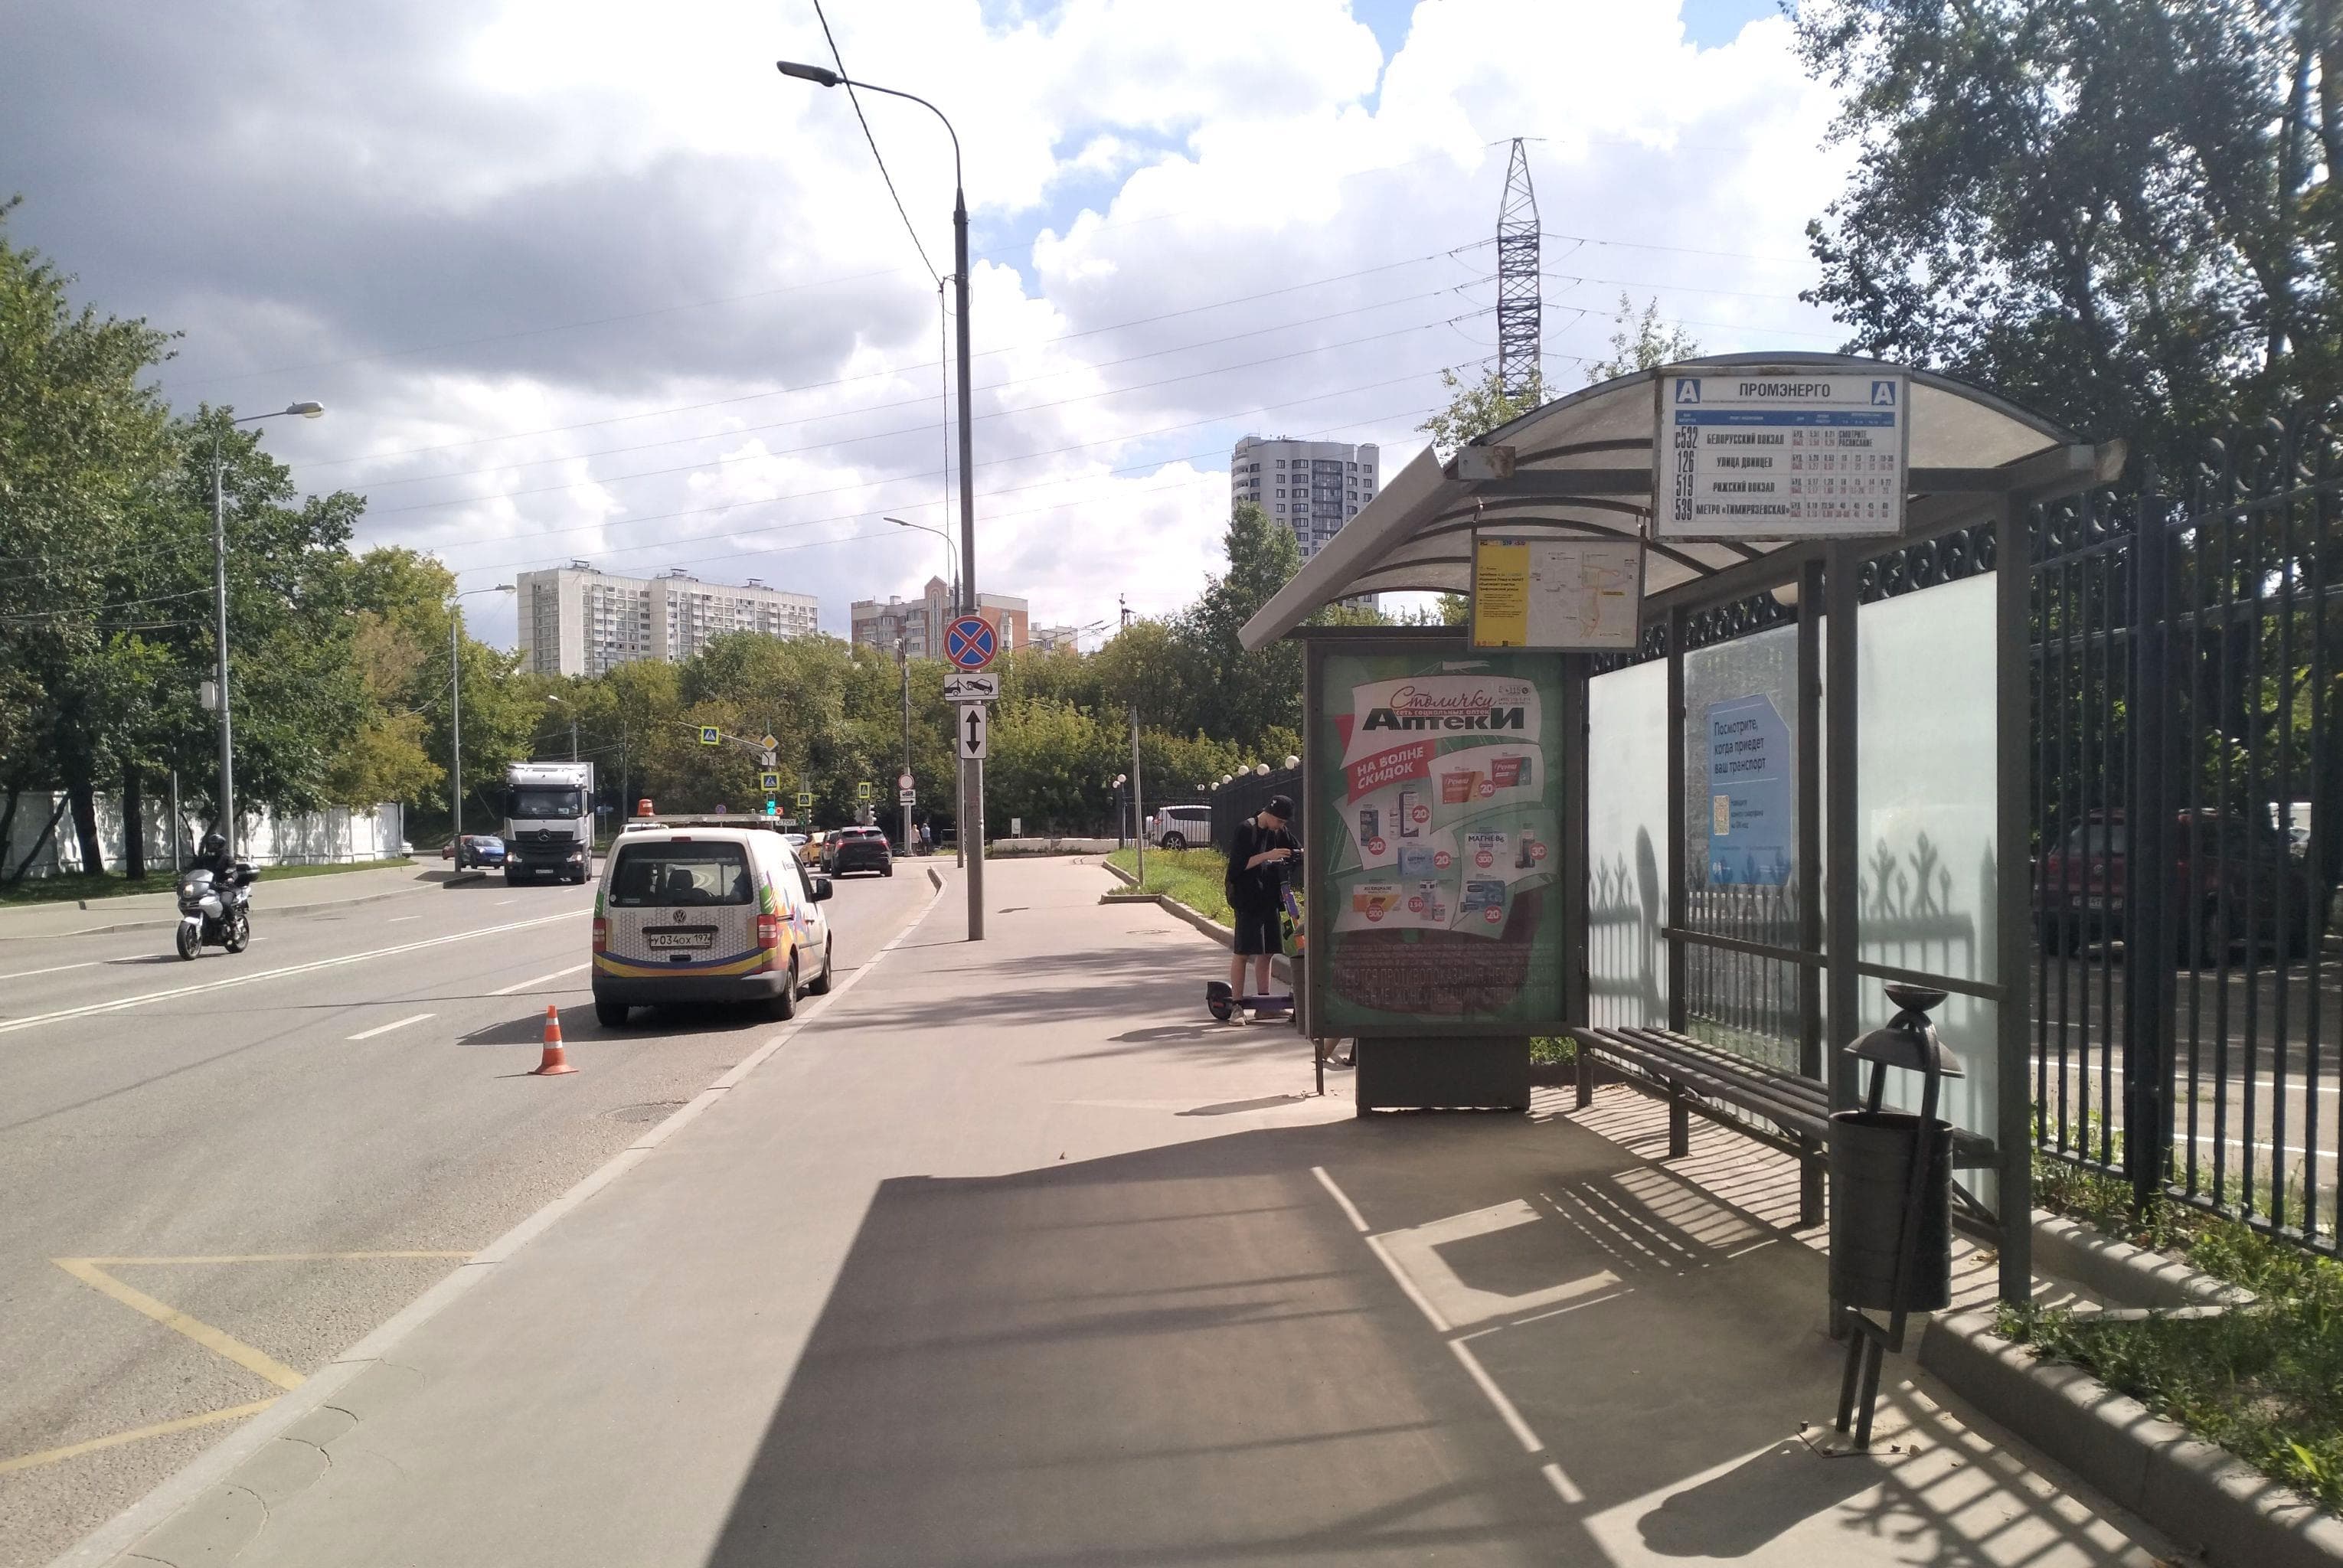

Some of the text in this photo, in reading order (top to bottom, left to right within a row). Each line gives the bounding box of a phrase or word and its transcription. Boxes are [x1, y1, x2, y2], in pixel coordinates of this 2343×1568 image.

[1740, 383, 1831, 398] ПРОМЭНЕРГО
[1707, 433, 1756, 445] БЕЛОРУССКИЙ
[1757, 434, 1785, 445] ВОКЗАЛ
[1678, 450, 1773, 473] 126 УЛИЦА ДВИНЦЕВ
[1676, 474, 1775, 497] 519 РИЖСКИЙ ВОКЗАЛ
[1675, 498, 1790, 521] 539 МЕТРО «ТИМИРЯЗЕВСКАЯ»
[1390, 685, 1497, 709] Столички
[1714, 719, 1759, 736] Посмотрите,
[1714, 737, 1765, 756] когда приедет
[1357, 746, 1424, 777] НА ВОЛНЕ
[1714, 757, 1766, 775] ваш транспорт
[1358, 762, 1413, 789] СКИДОК
